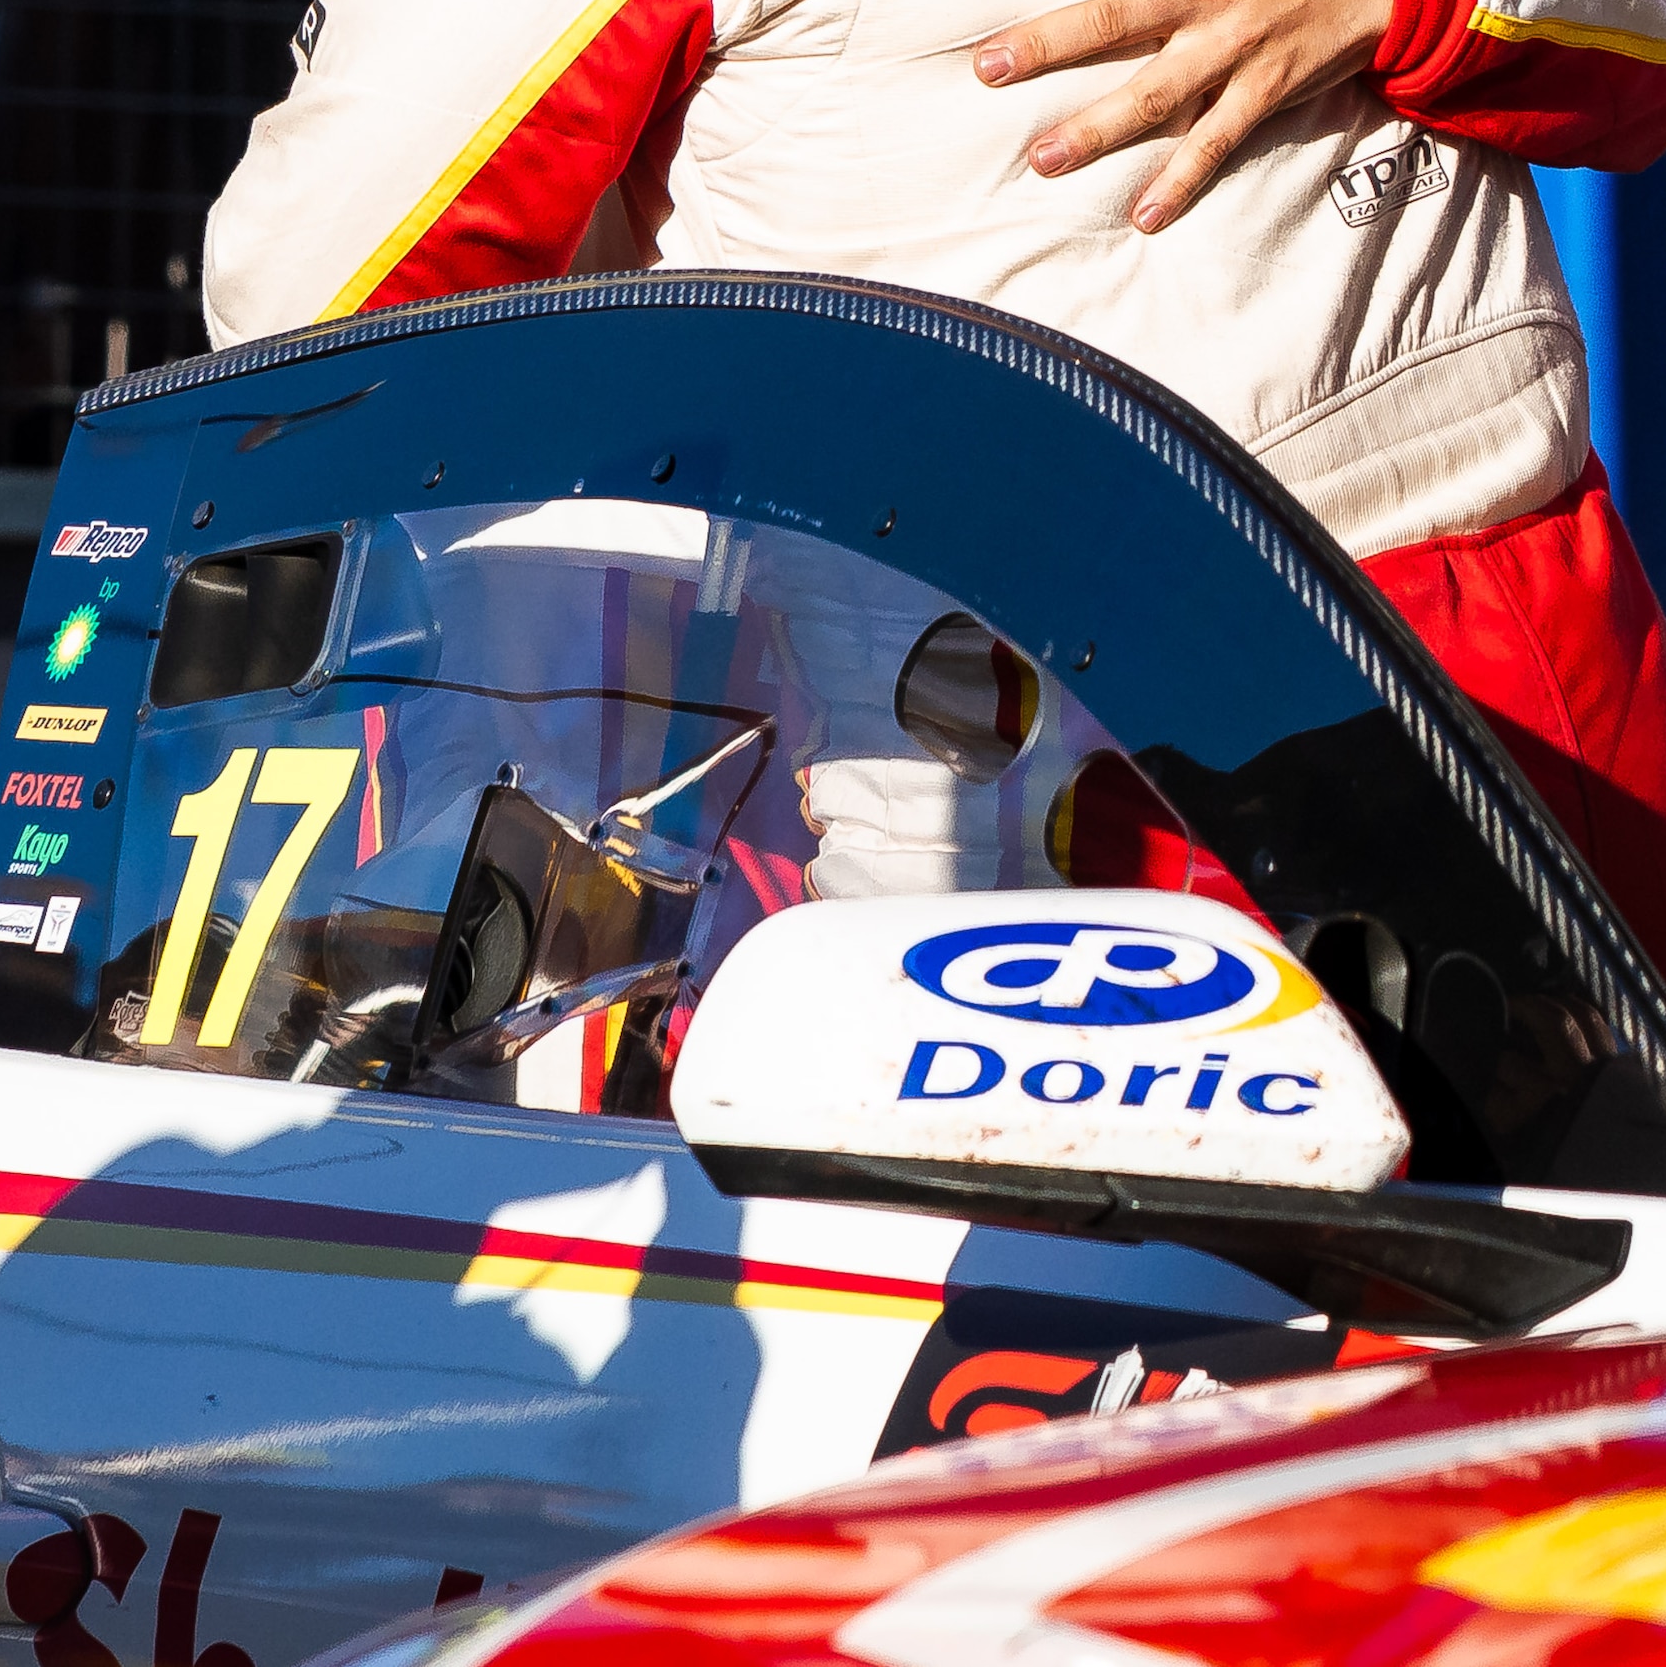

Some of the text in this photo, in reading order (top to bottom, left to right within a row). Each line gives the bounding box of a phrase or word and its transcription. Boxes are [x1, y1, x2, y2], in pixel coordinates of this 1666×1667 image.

[1337, 138, 1432, 199] rpm
[1347, 171, 1443, 219] RACWEAR
[76, 524, 146, 560] Repco
[98, 576, 121, 603] bp
[32, 717, 98, 731] DUNLOP
[0, 772, 84, 809] FOXTEL
[8, 862, 38, 875] SPORTS
[13, 824, 69, 877] Kayo
[139, 747, 361, 1048] 17
[896, 1040, 1322, 1116] Doric
